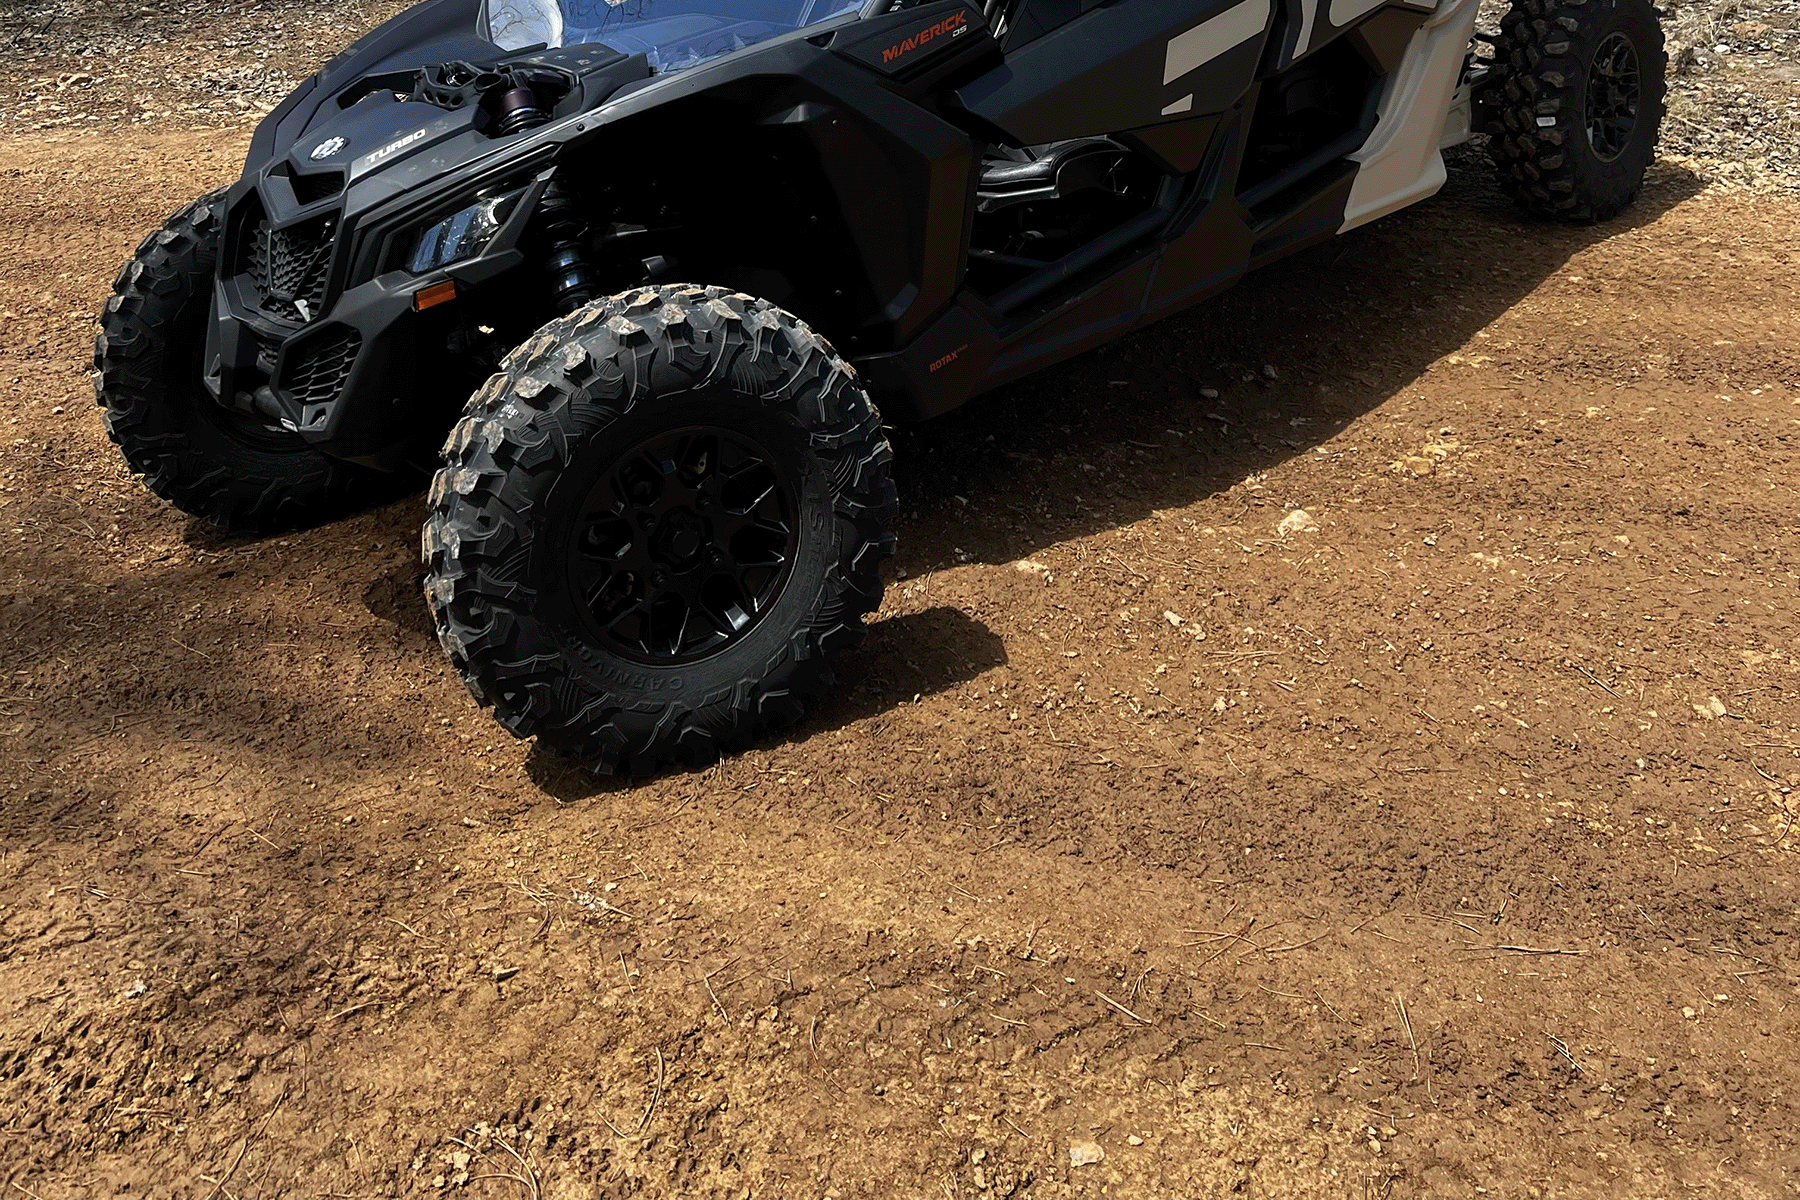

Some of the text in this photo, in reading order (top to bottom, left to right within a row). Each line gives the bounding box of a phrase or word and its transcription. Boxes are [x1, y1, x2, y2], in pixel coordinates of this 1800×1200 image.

[881, 10, 966, 63] MAVERICK
[952, 25, 968, 38] DS
[366, 128, 426, 163] TURBO
[929, 350, 958, 373] ROTAX
